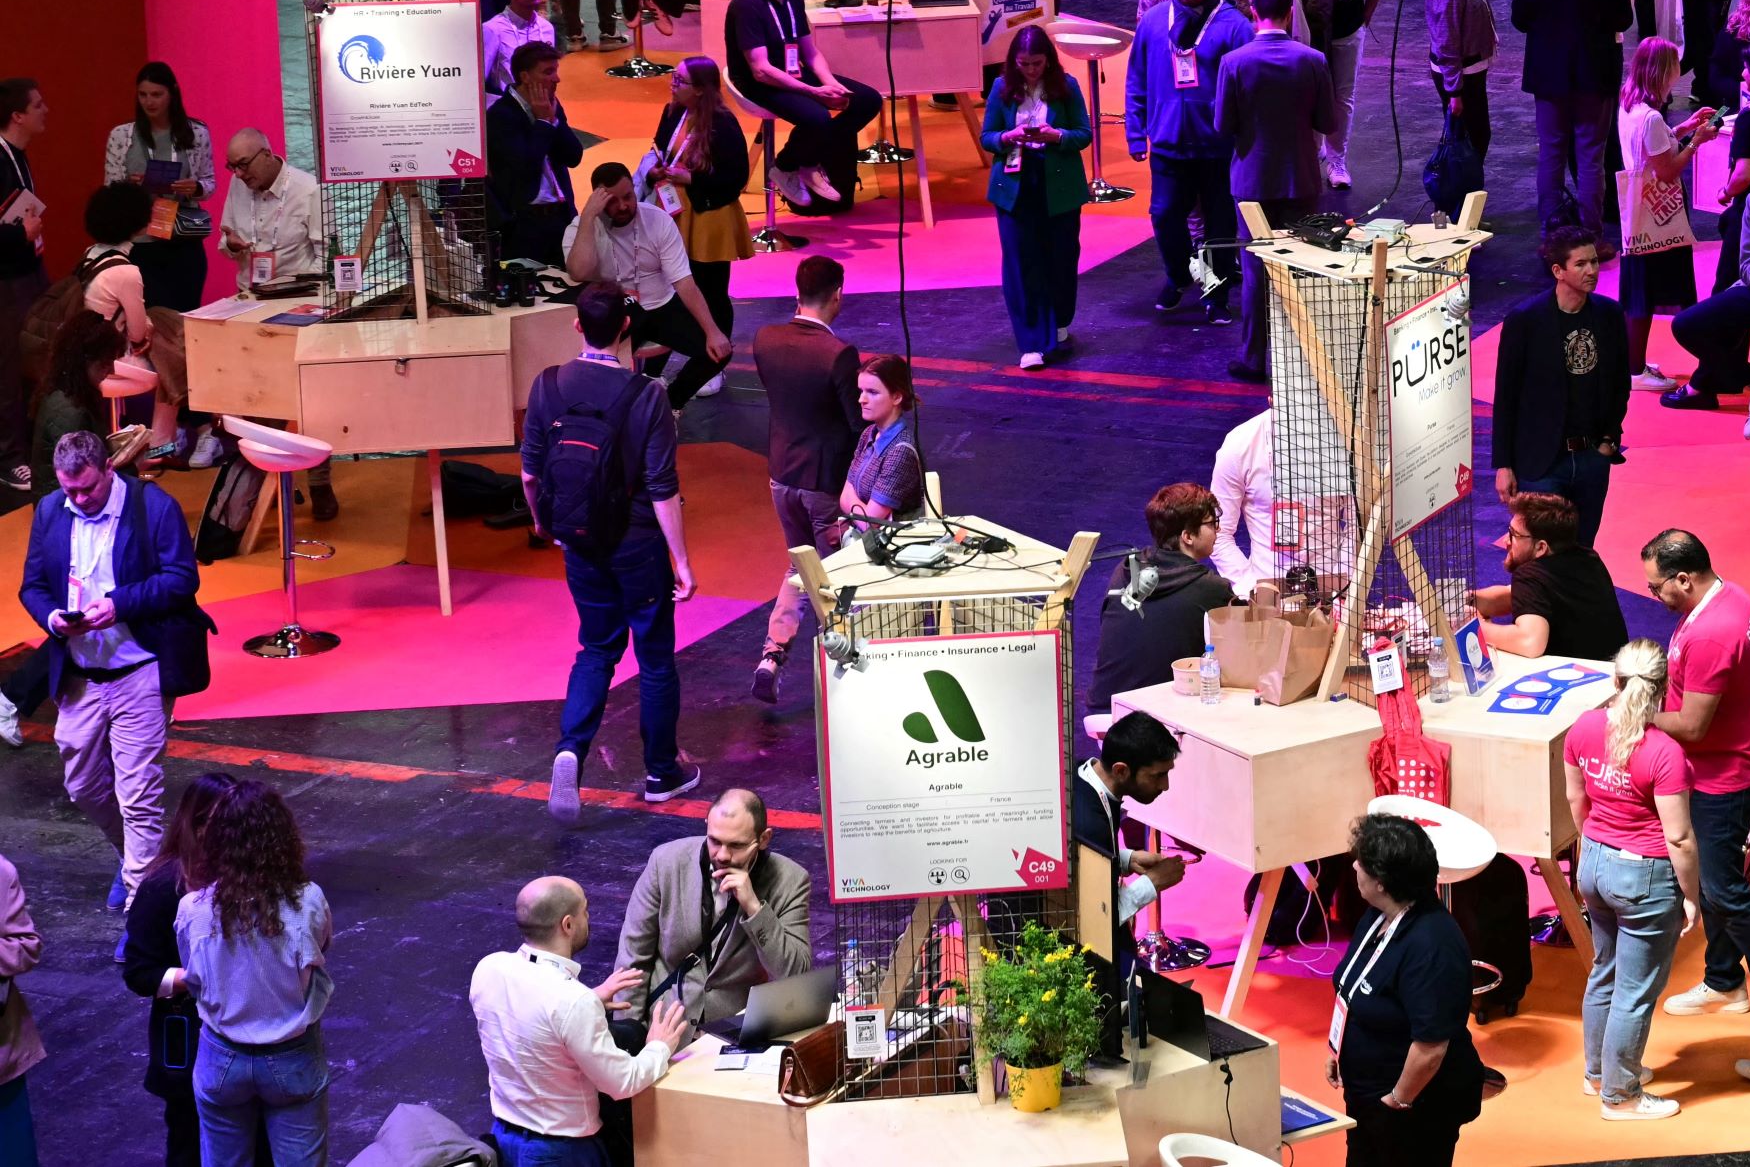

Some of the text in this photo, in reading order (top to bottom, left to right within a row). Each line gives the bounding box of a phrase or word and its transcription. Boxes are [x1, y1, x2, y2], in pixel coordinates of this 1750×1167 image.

[361, 64, 461, 80] Rivière Yuan
[457, 158, 476, 167] C51
[1624, 233, 1651, 246] VIVA
[1624, 235, 1685, 254] TECHNOLOGY
[1392, 324, 1468, 398] PÜRSE
[1418, 381, 1439, 403] Make
[897, 642, 1036, 659] Finance Insurance Legal
[905, 745, 989, 769] Agrable
[928, 782, 963, 792] Agrable
[866, 801, 920, 812] Conception stage
[990, 796, 1012, 804] France
[1028, 860, 1056, 873] C49
[842, 878, 865, 886] VIVA
[1034, 875, 1049, 883] 001
[842, 884, 891, 893] TECHNOLOGY
